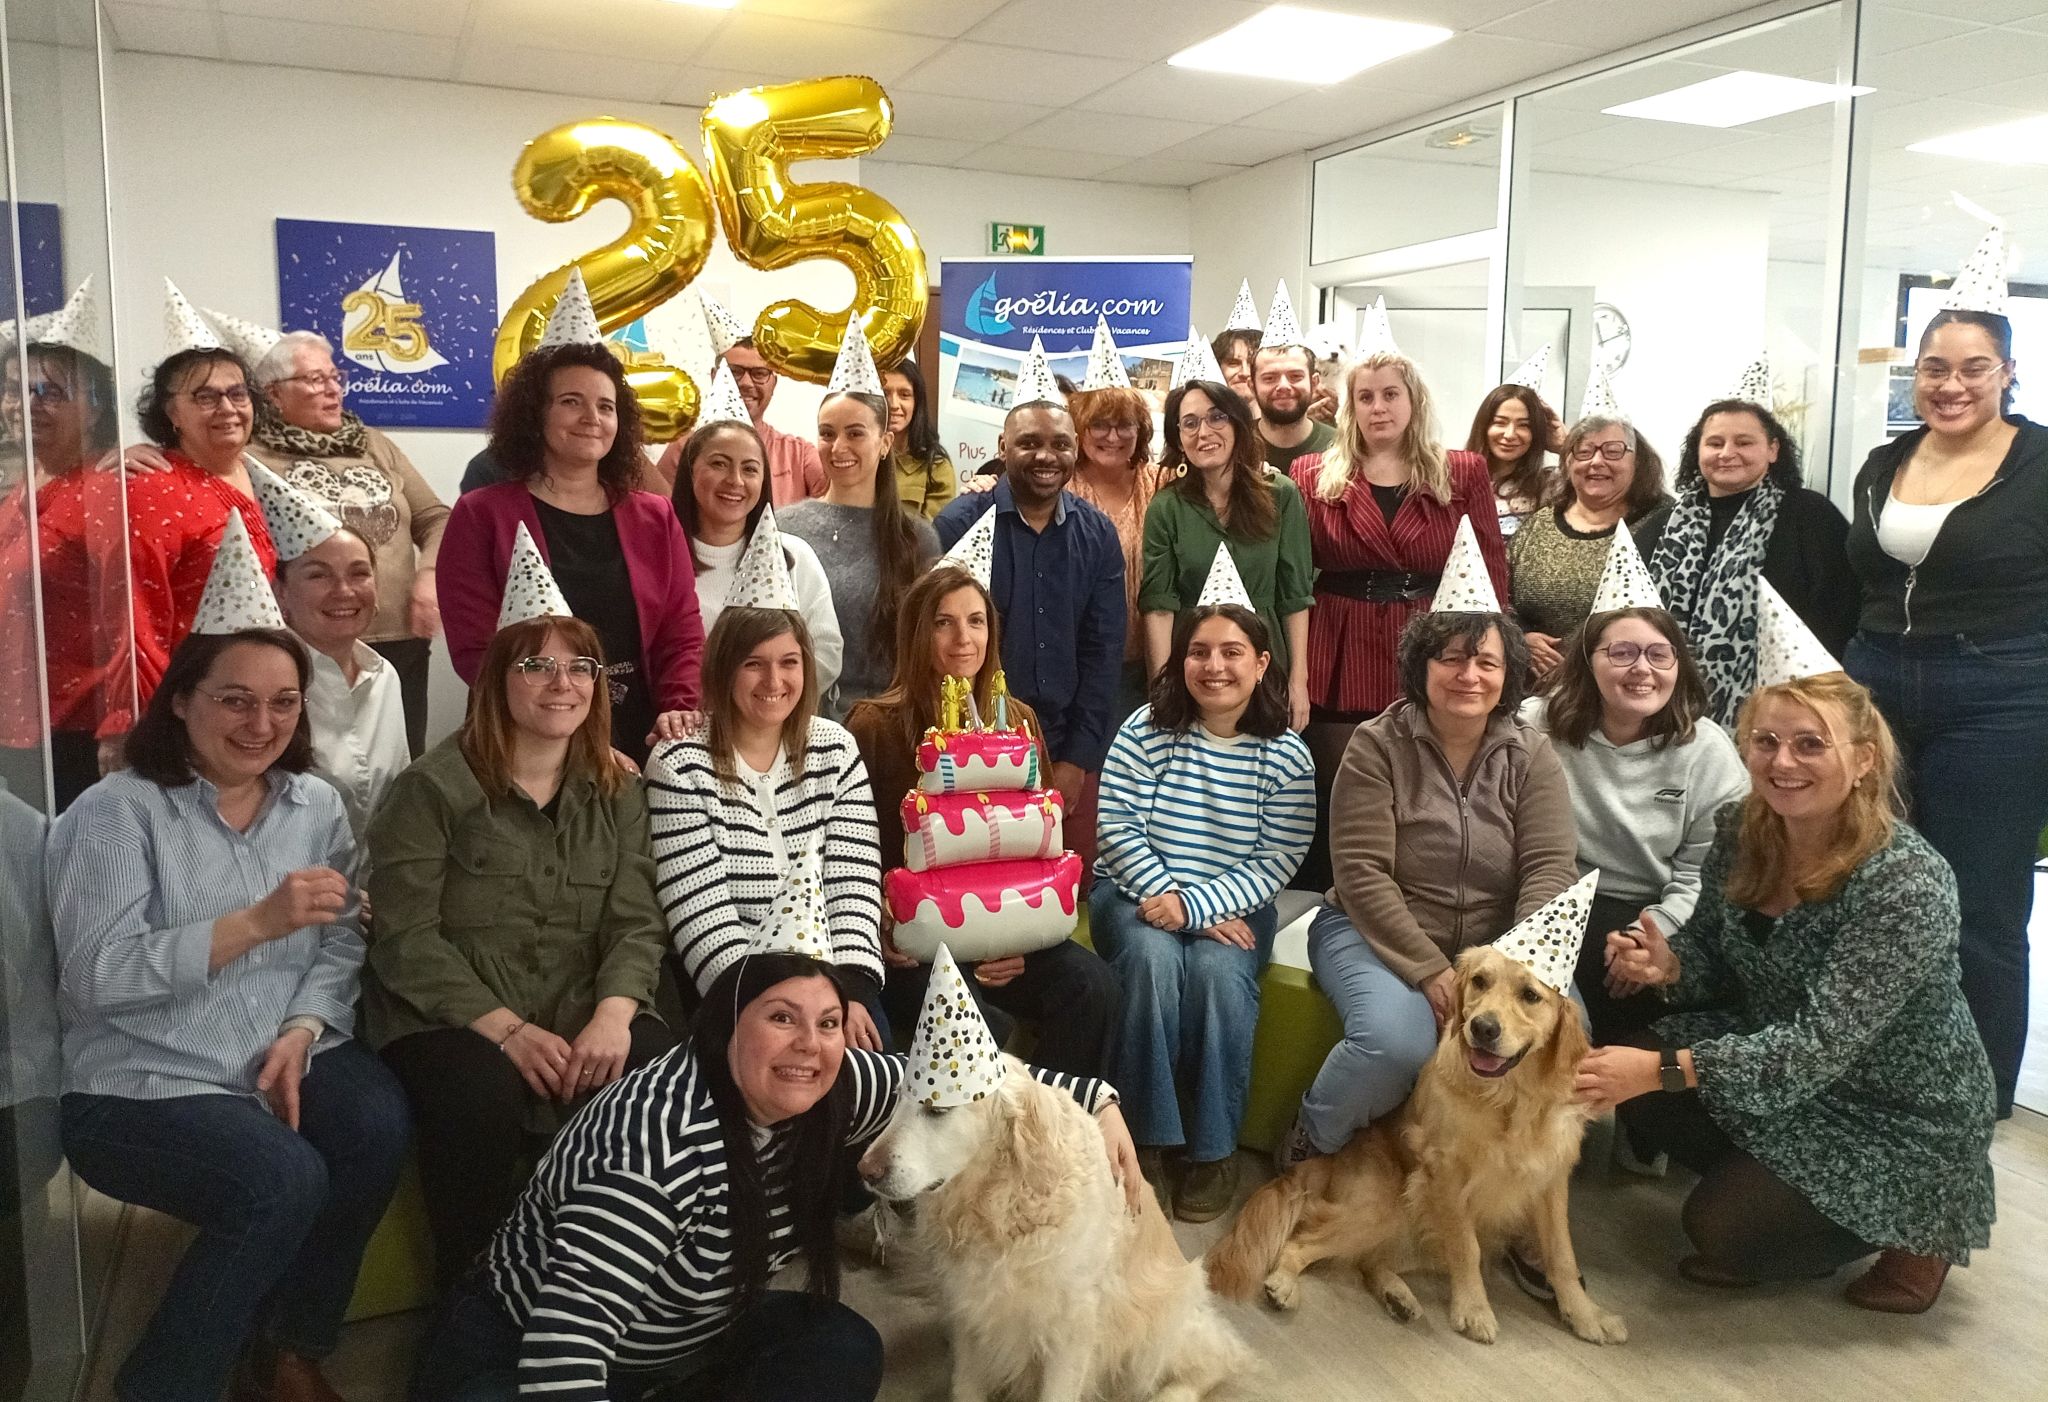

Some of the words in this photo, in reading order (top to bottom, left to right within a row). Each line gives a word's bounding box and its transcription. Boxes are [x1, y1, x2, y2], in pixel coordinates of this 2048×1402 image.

[342, 290, 428, 362] 25
[1022, 326, 1066, 335] Résidences
[1111, 327, 1151, 335] Vacances
[959, 442, 987, 459] Plus
